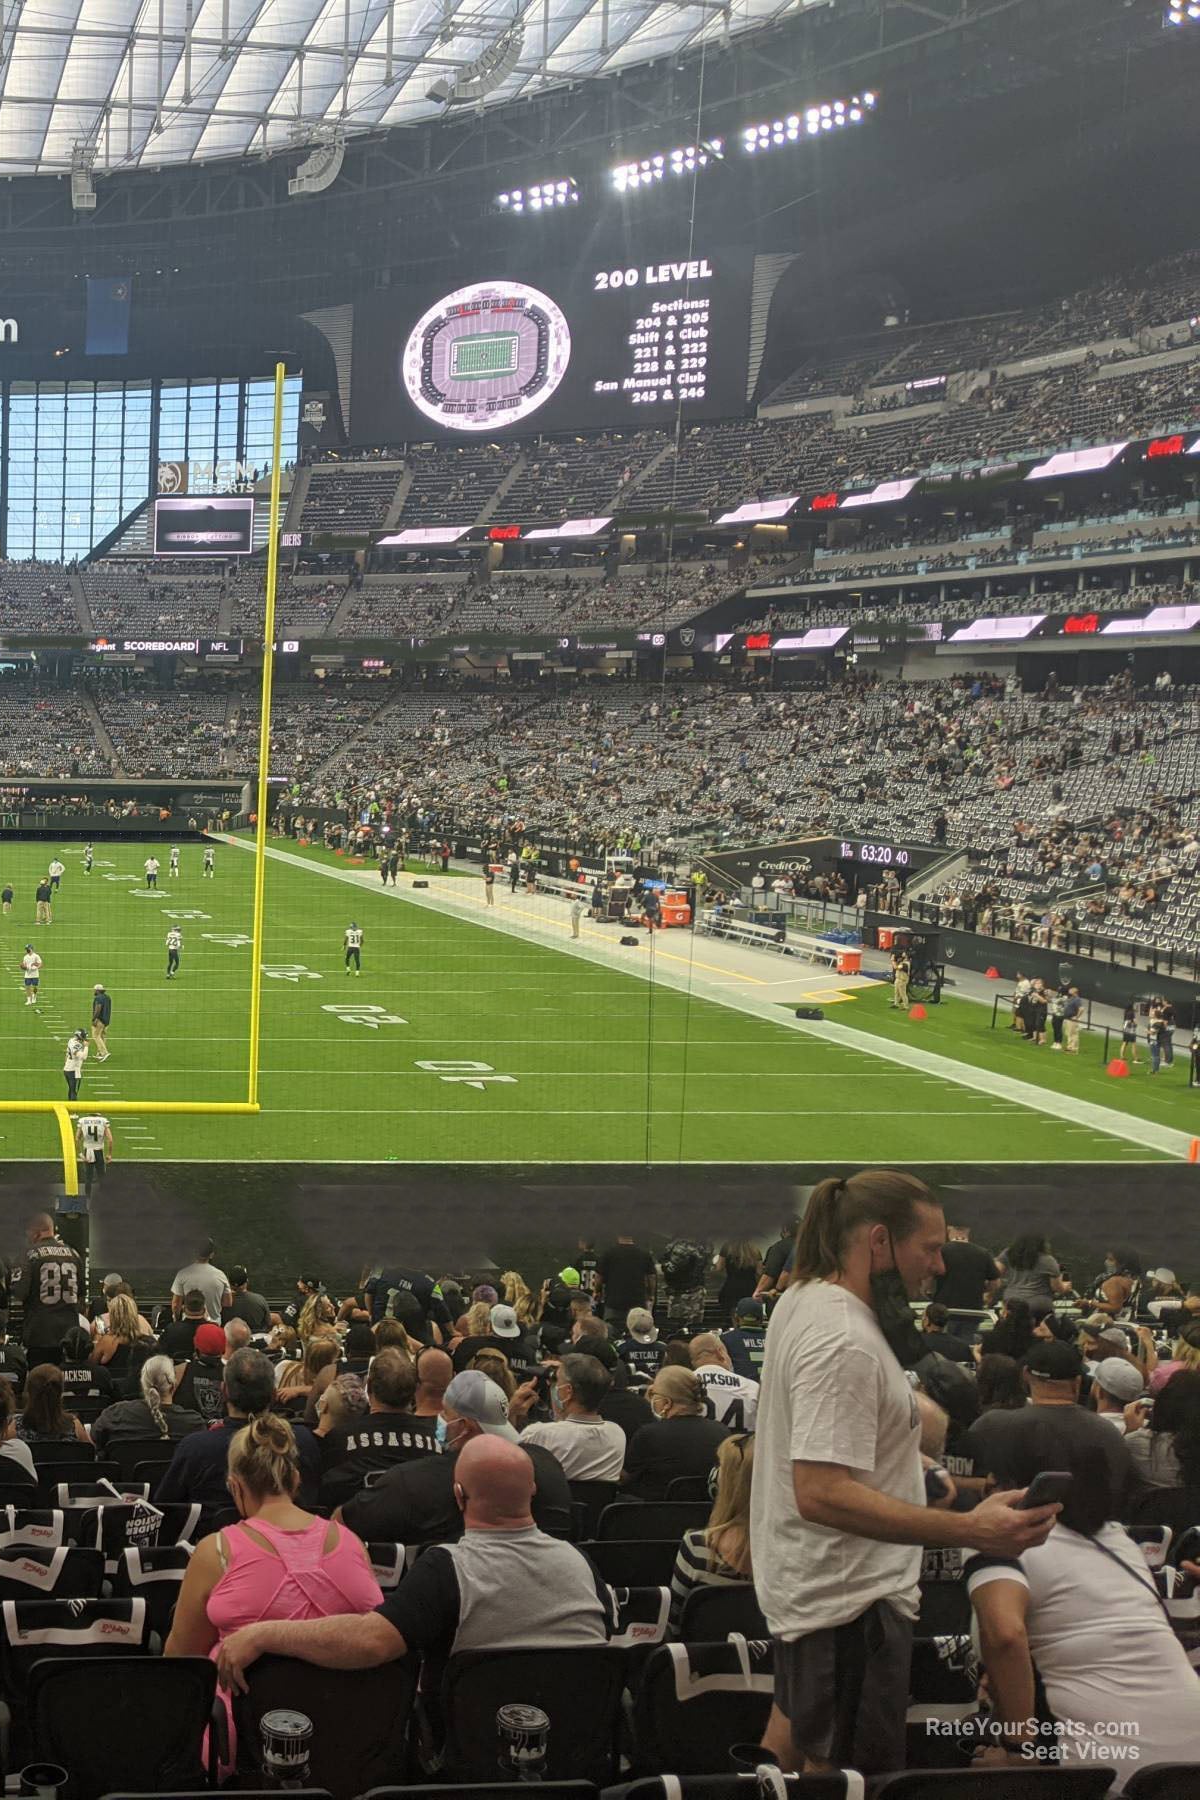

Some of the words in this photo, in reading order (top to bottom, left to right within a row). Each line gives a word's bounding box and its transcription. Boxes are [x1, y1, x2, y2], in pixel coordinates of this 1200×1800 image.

[594, 268, 639, 290] 200
[645, 260, 713, 284] LEVEL
[651, 299, 709, 313] Sections:
[636, 317, 661, 330] 204
[666, 315, 678, 326] &
[683, 312, 709, 325] 205
[628, 331, 660, 345] Shift
[664, 330, 674, 341] 4
[679, 327, 709, 340] Club
[634, 346, 658, 359] 221
[665, 345, 676, 356] &
[681, 342, 708, 354] 222
[633, 361, 659, 374] 228
[664, 360, 675, 370] &
[680, 357, 707, 369] 229
[594, 380, 618, 392] San
[622, 374, 672, 389] Manuel
[677, 372, 706, 384] Club
[632, 391, 657, 403] 245
[662, 389, 674, 400] &
[679, 387, 705, 399] 246
[193, 462, 255, 481] MGM
[282, 534, 302, 547] IDERS
[124, 641, 196, 651] SCOREBOARD
[211, 642, 229, 651] NFL
[861, 844, 892, 863] 63:20
[896, 851, 908, 864] 40
[169, 937, 178, 947] 22
[350, 934, 360, 944] 31
[88, 1126, 98, 1142] 4
[40, 1262, 79, 1304] 83
[629, 1351, 659, 1361] METCALF
[696, 1373, 741, 1388] ACKSON
